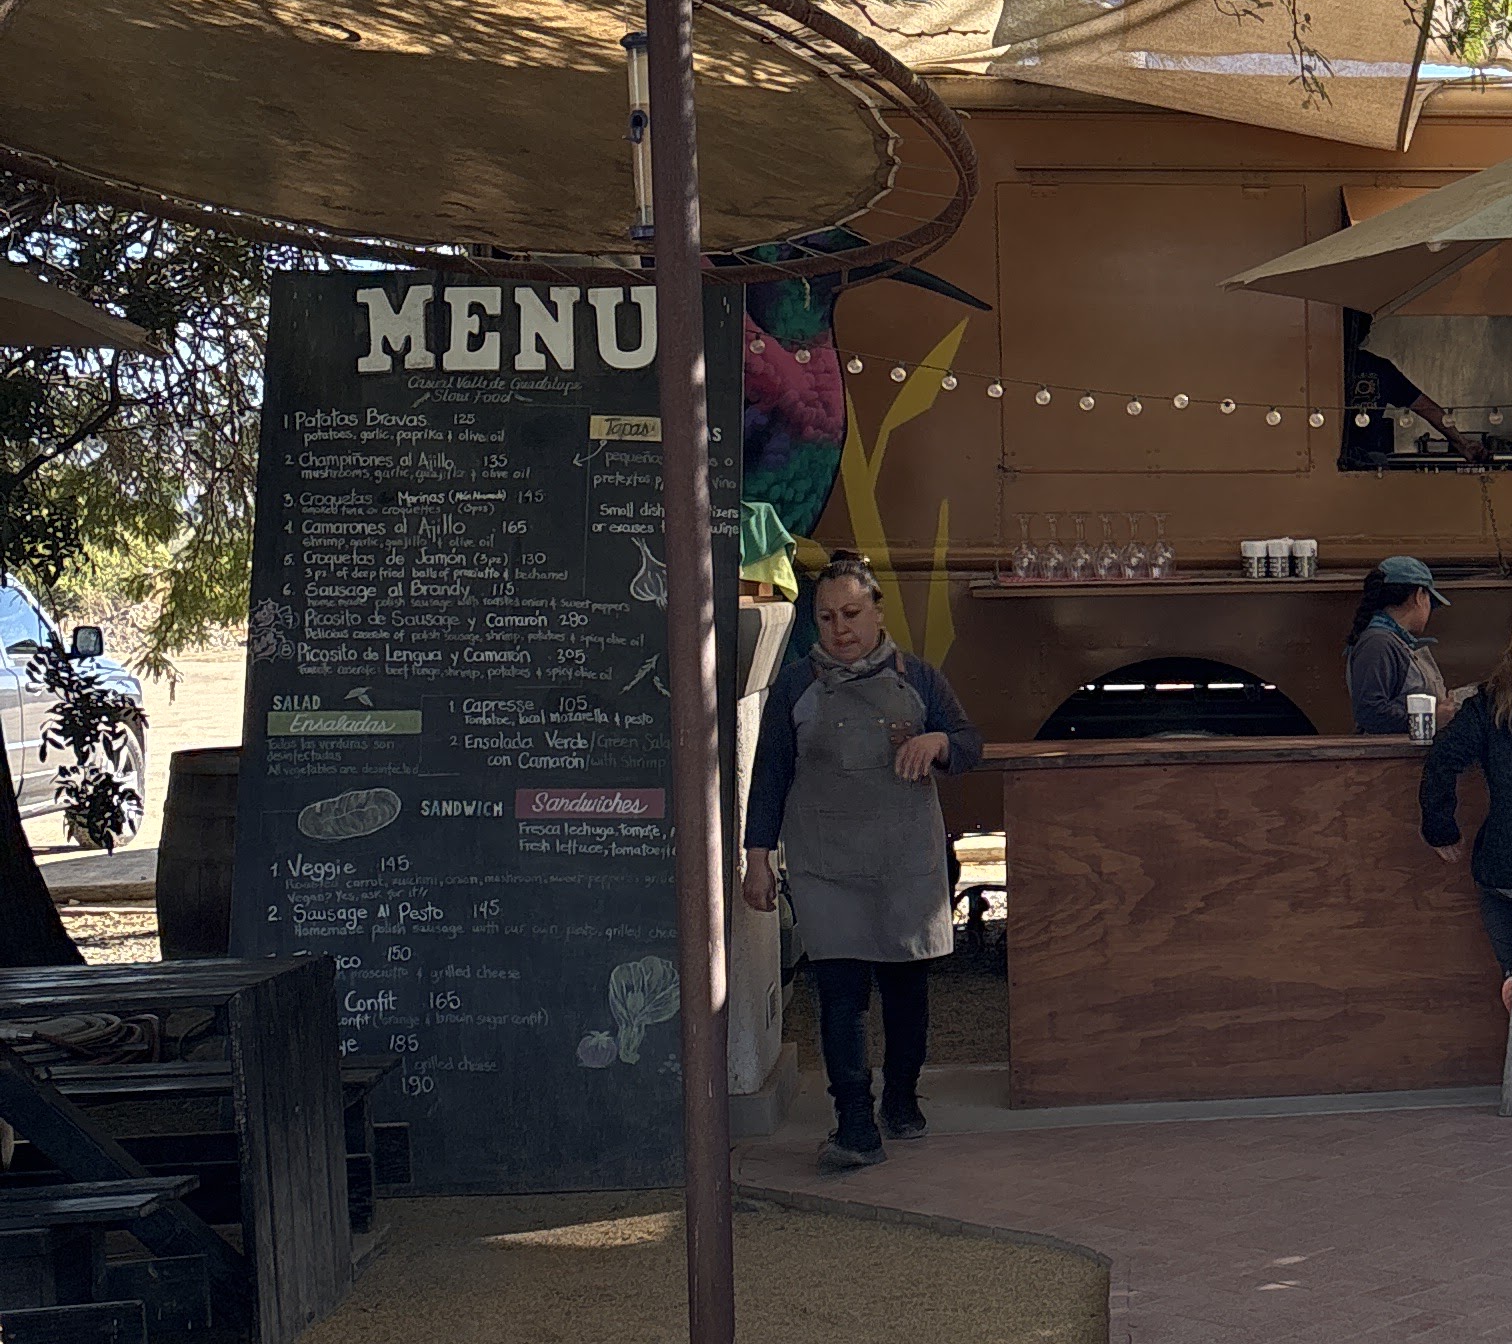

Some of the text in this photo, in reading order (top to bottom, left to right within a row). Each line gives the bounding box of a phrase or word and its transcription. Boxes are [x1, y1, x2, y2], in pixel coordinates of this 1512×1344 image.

[356, 285, 657, 374] MENU
[431, 389, 512, 404] Slow Food
[294, 407, 476, 431] Patatas Bravas 125
[458, 429, 487, 443] olive
[490, 429, 505, 442] oil
[284, 451, 508, 471] 2 Champiñones al Ajillo 135
[513, 467, 531, 479] oil
[300, 489, 374, 510] Croquetas
[398, 491, 445, 506] Marinas
[518, 491, 544, 503] 145
[600, 502, 633, 517] Small
[302, 514, 527, 542] Camarones al Ajillo 165
[592, 523, 606, 532] or
[479, 533, 494, 548] oil
[303, 547, 547, 571] Croquetas de Jamón 130
[336, 567, 349, 580] of
[379, 567, 405, 580] fried
[438, 567, 450, 581] of
[305, 578, 516, 602] Sausage al Brandy 115
[305, 608, 588, 633] Picosito de Sausage y Camarón 280
[630, 634, 645, 647] oil
[297, 642, 586, 666] Picosito de Lengua y Camarón 305
[599, 666, 613, 681] oil
[272, 694, 321, 711] SALAD
[462, 695, 588, 714] Capresse 105
[289, 713, 396, 733] Ensaladas
[625, 713, 654, 728] pesto
[373, 739, 394, 750] son
[449, 732, 534, 749] 2 Ensalada
[487, 755, 511, 767] con
[420, 801, 503, 817] SANDWICH
[531, 793, 648, 814] Sandwiches
[518, 823, 561, 837] Fresca
[518, 839, 551, 854] Fresh
[287, 853, 409, 881] Veggie 145
[293, 904, 368, 930] Sausage
[398, 901, 444, 924] Pesto
[472, 899, 500, 919] 145
[387, 946, 412, 962] 150
[431, 964, 521, 984] grilled cheese
[344, 990, 461, 1012] Confit 165
[435, 1012, 507, 1030] brown sugar
[389, 1034, 420, 1052] 185
[413, 1056, 499, 1075] grilled cheese
[402, 1076, 434, 1095] 190
